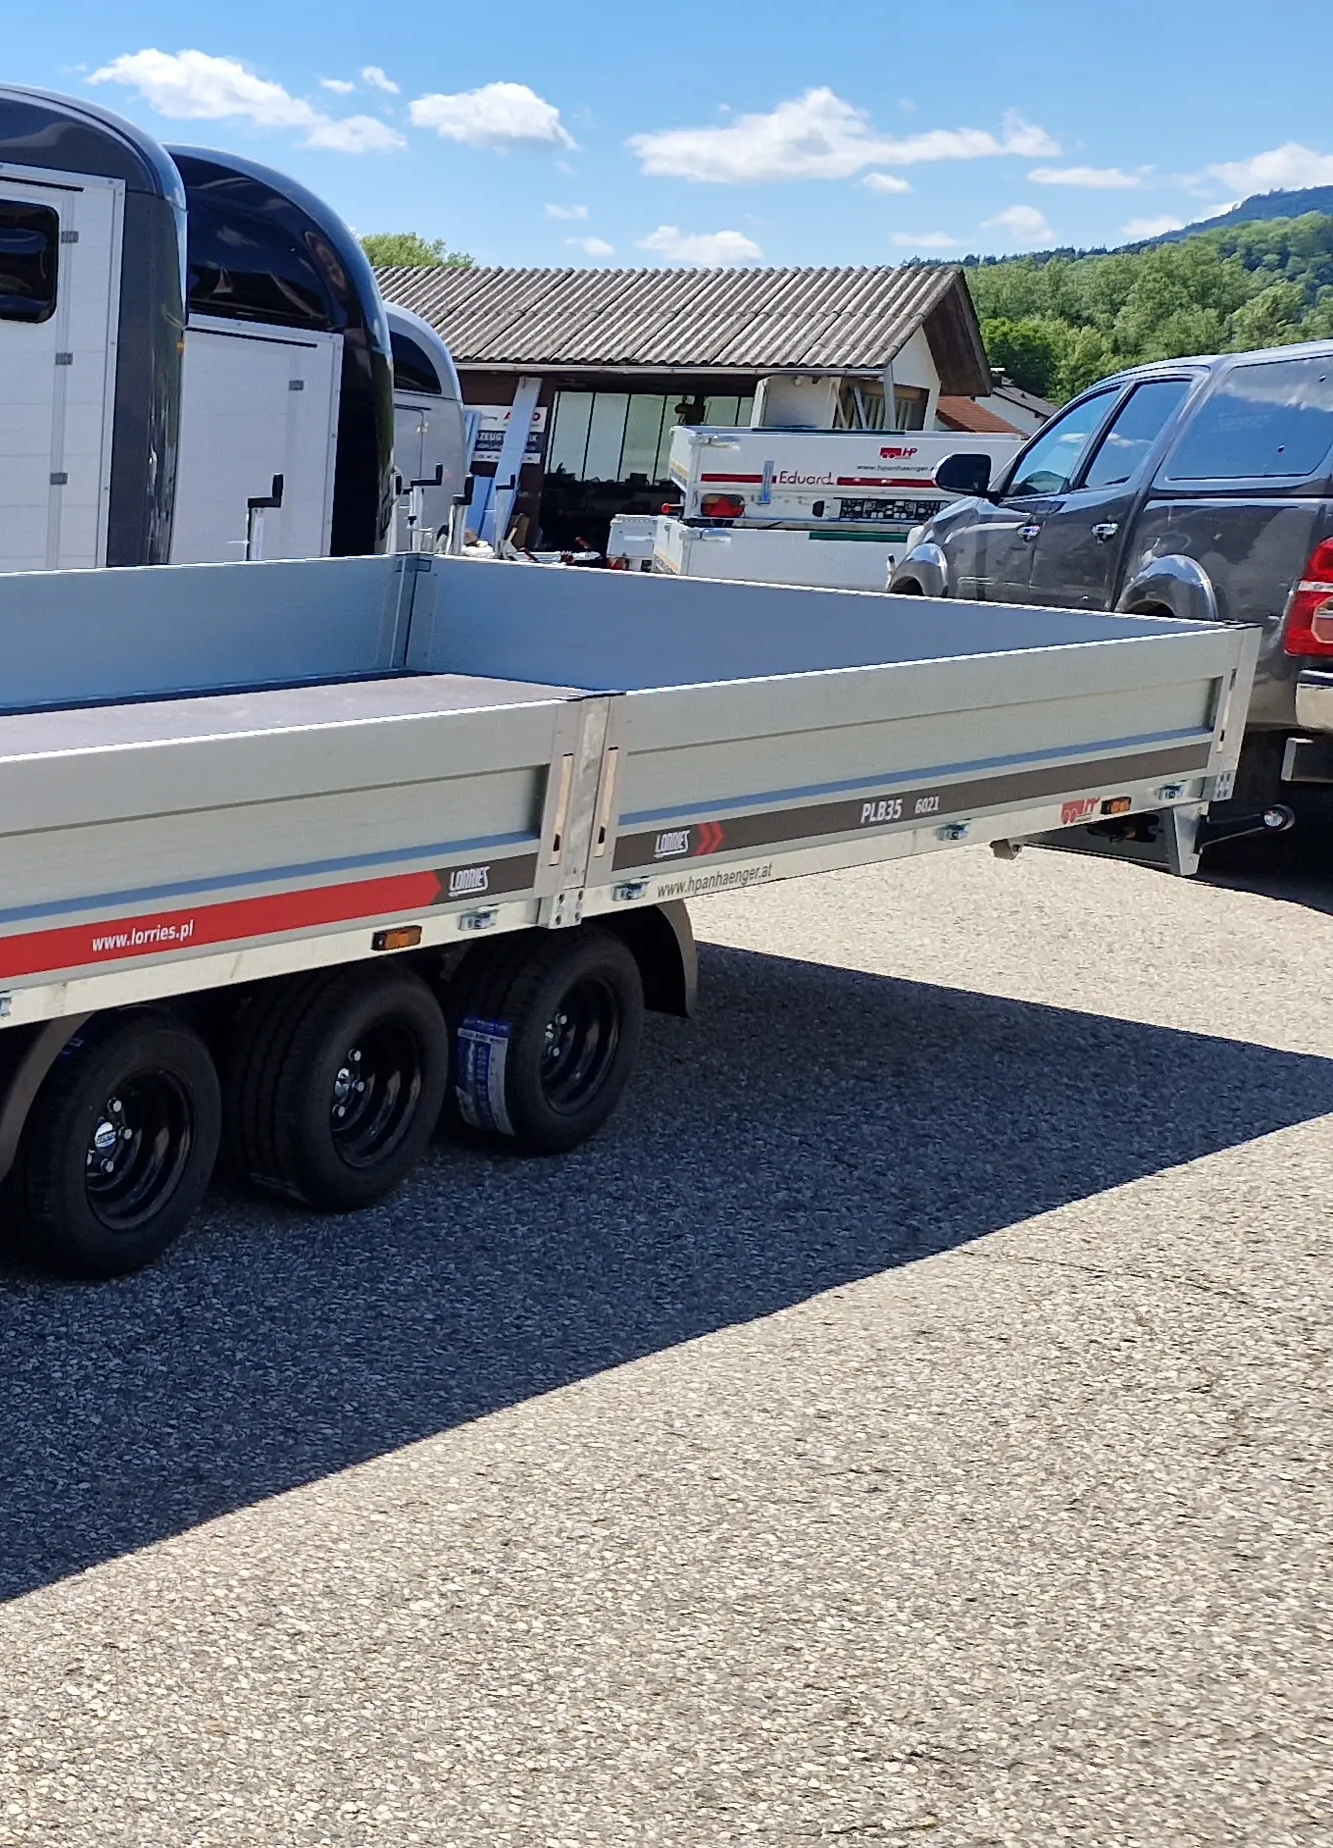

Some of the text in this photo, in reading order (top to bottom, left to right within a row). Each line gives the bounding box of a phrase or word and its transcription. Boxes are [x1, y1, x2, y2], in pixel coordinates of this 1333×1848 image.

[779, 471, 834, 486] Eduard
[861, 795, 940, 824] PLB35 6021
[449, 865, 491, 896] LORRIES
[657, 862, 773, 898] www.hpanhaenger.at
[92, 919, 194, 952] www.lorries.pl
